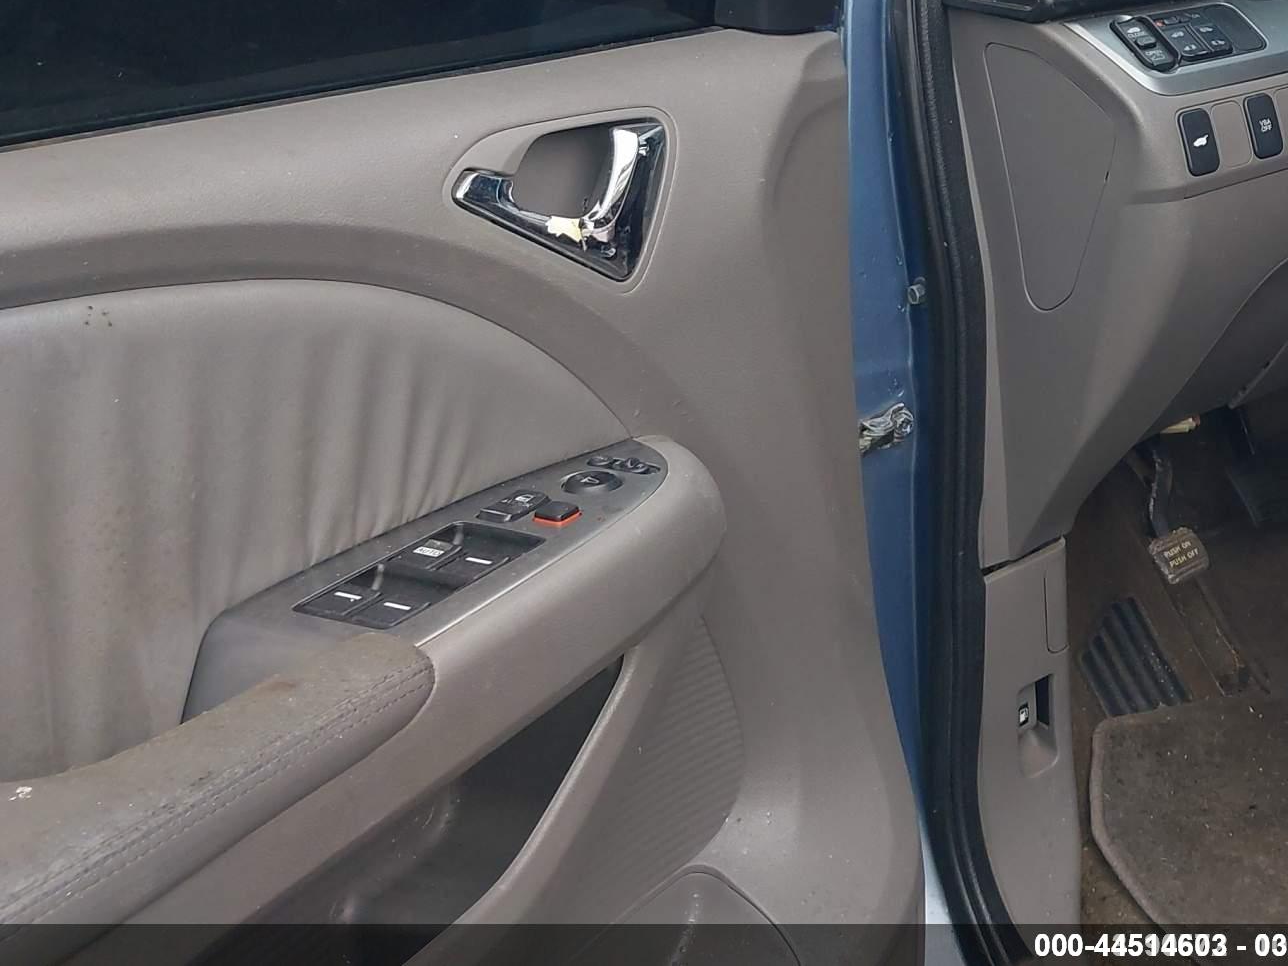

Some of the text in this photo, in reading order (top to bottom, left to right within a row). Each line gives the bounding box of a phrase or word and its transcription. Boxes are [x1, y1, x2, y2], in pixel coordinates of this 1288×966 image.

[1163, 541, 1191, 559] PUSH ON
[1169, 548, 1198, 567] PUSH OFF
